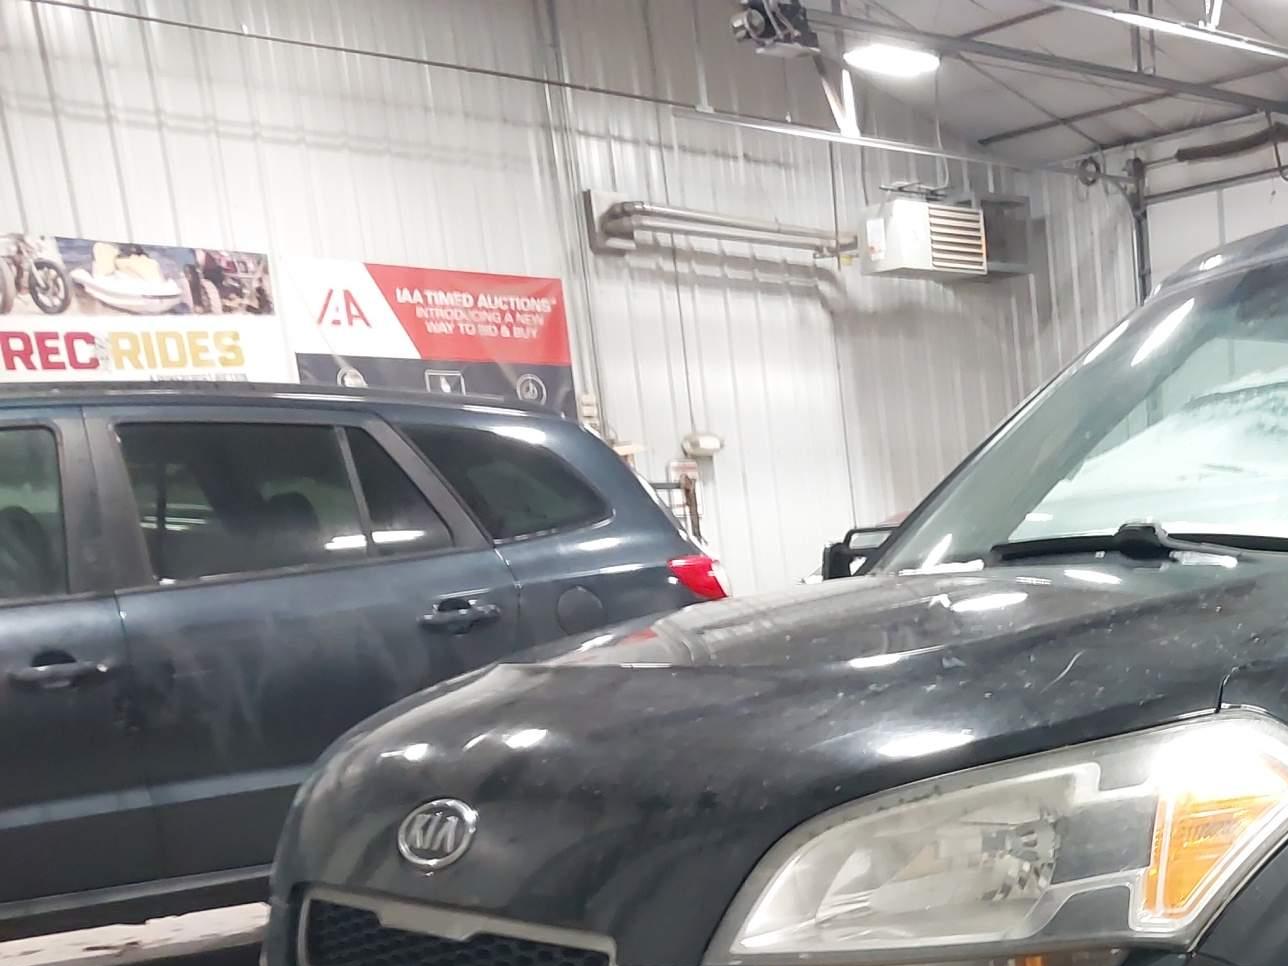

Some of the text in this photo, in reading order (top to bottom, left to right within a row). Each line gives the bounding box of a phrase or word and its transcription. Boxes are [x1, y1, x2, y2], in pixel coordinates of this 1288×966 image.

[396, 288, 423, 304] IAA
[424, 289, 475, 307] TIMED
[416, 306, 545, 326] INTRODUCING A NEW
[426, 322, 455, 335] WAY
[458, 323, 476, 335] TO
[513, 326, 539, 338] BUY
[0, 331, 100, 370] REC
[109, 331, 245, 369] RIDES
